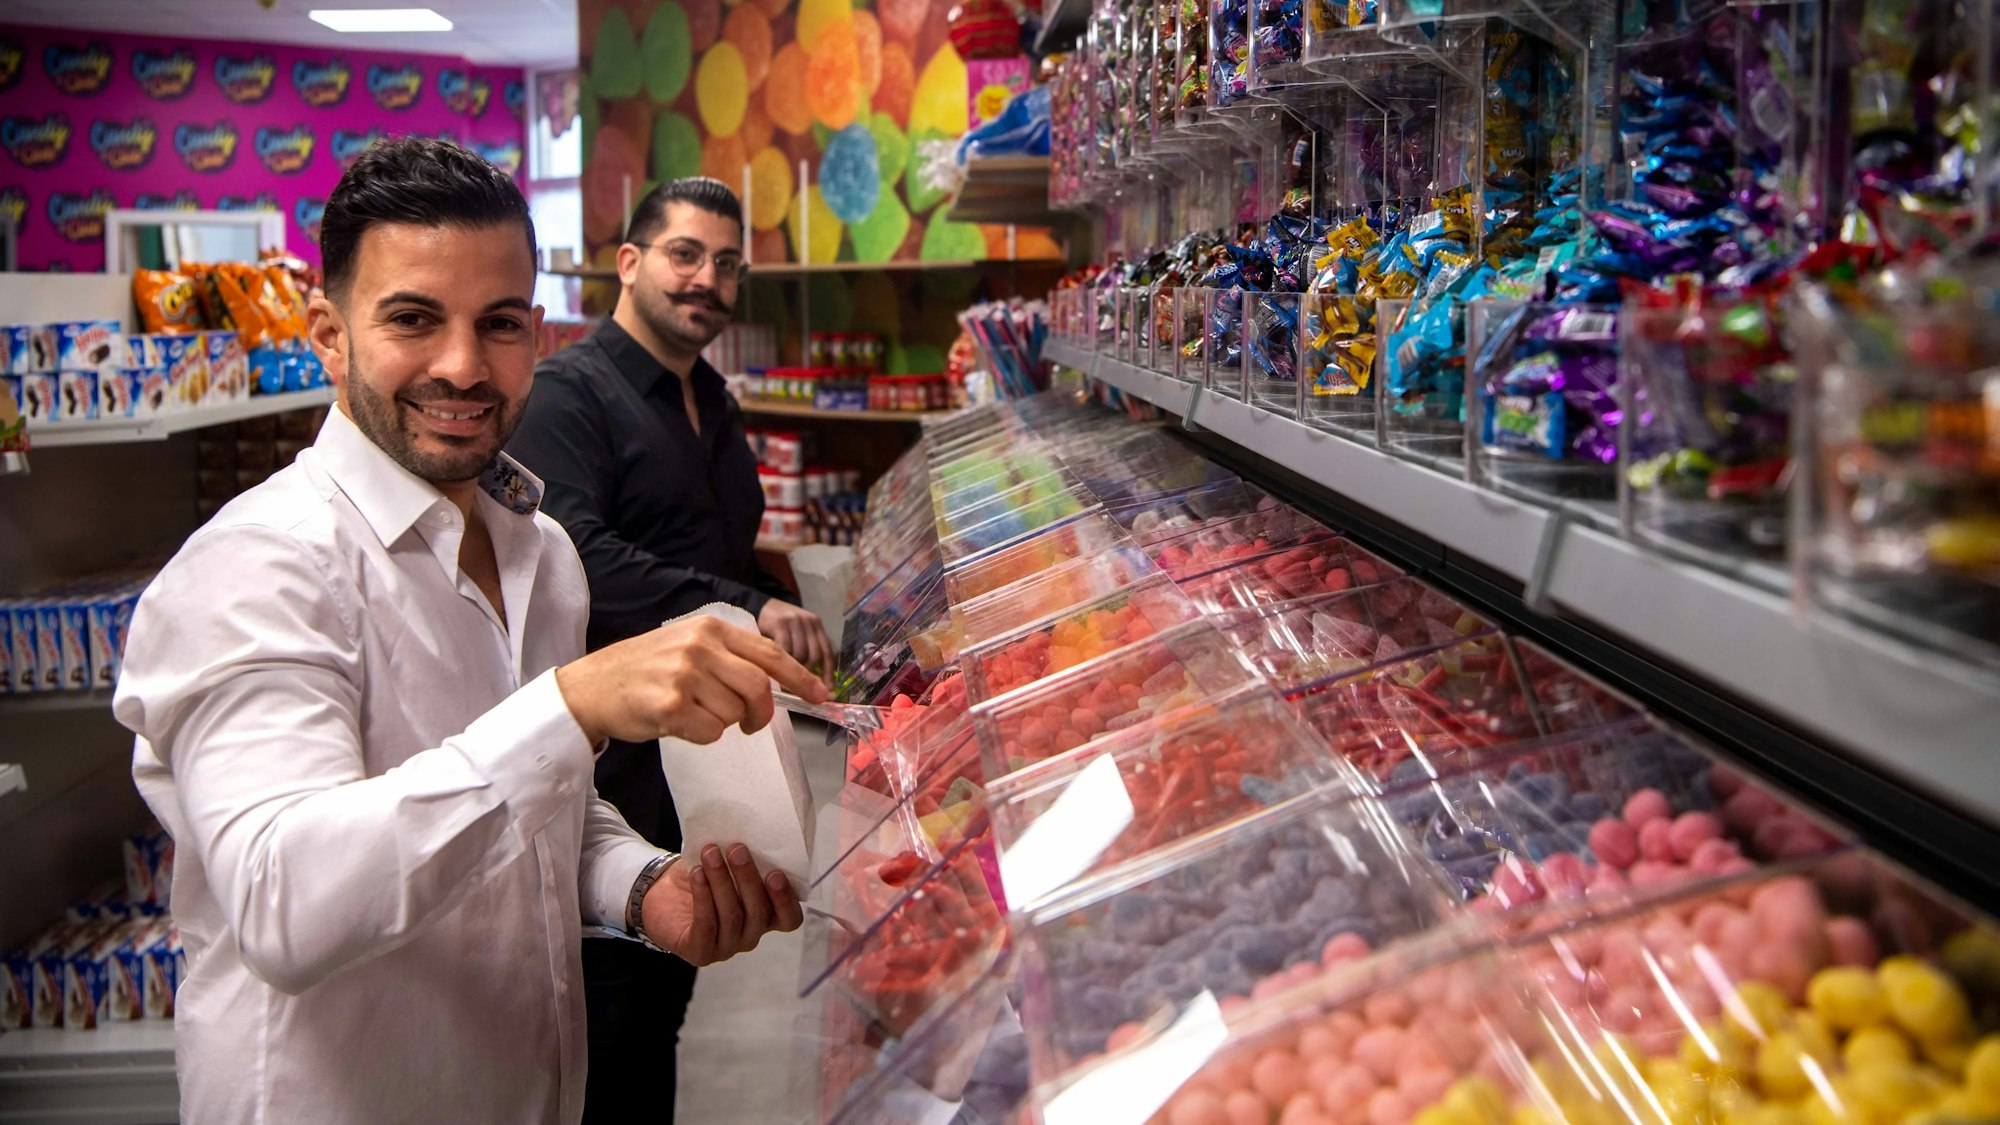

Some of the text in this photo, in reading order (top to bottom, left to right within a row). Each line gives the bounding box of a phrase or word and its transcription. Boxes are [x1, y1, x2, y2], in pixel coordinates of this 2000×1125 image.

[45, 45, 111, 79] Candy
[132, 50, 195, 83] Candy
[215, 55, 274, 88] Candy
[293, 59, 350, 90] Candy
[367, 63, 421, 95] Candy
[2, 117, 68, 151] Candy
[90, 118, 155, 154] Candy
[175, 121, 236, 157] Candy
[255, 125, 315, 159] Candy
